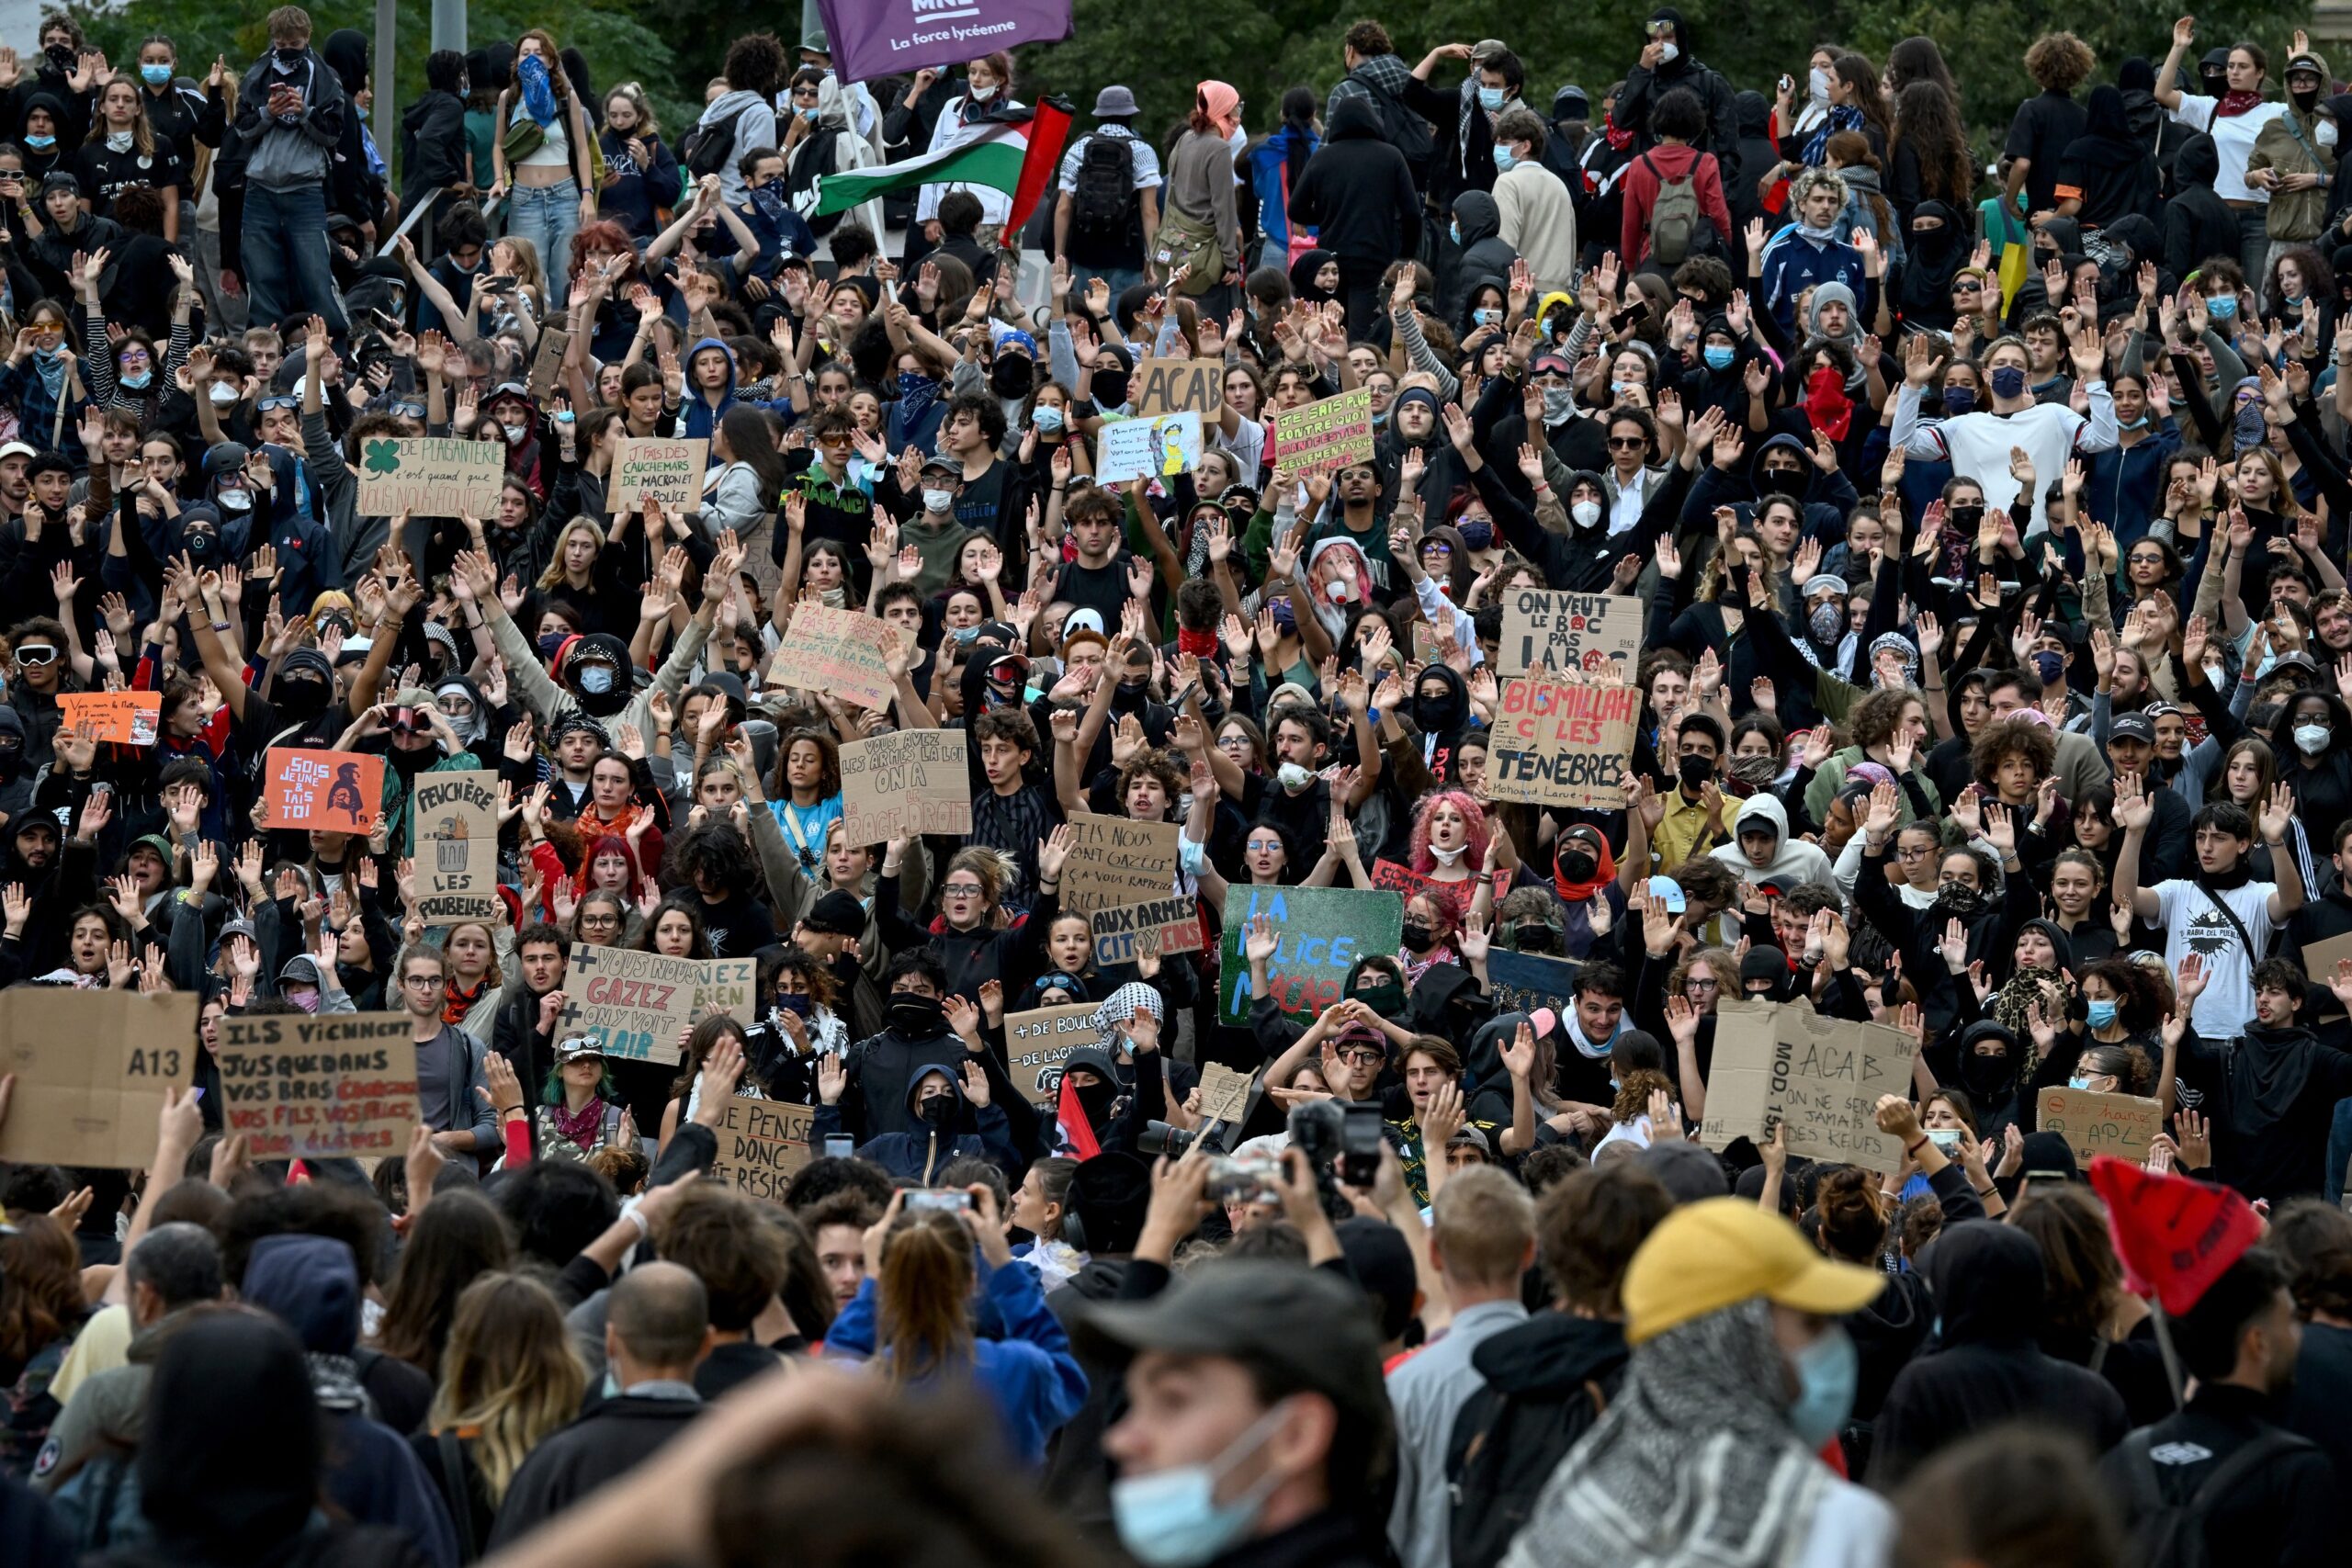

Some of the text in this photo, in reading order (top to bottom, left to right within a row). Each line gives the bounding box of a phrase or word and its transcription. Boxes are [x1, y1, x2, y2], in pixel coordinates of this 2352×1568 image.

[891, 20, 1015, 51] La force lycéenne
[1140, 367, 1221, 412] ACAB
[1279, 412, 1303, 427] JE
[1346, 391, 1371, 409] PLUS
[1277, 419, 1332, 442] CONTRE
[401, 440, 418, 456] DE
[643, 446, 662, 460] FAIS
[664, 447, 688, 458] DES
[1279, 442, 1347, 470] TELLEMENT
[1349, 437, 1373, 450] VOUS
[396, 467, 491, 486] c'est quand que
[623, 461, 689, 473] CAUCHEMARS
[622, 474, 694, 487] DE MACRON ET
[361, 485, 391, 514] VOUS
[397, 486, 431, 515] NOUS
[828, 610, 838, 620] 2
[1518, 592, 1611, 617] ON VEUT
[800, 616, 824, 630] PAS
[826, 622, 842, 633] DE
[1531, 615, 1601, 634] LE BAC
[1548, 633, 1581, 647] PAS
[799, 642, 819, 651] CAF
[843, 651, 857, 661] LA
[800, 671, 815, 684] TU
[865, 687, 882, 698] ME
[1518, 718, 1535, 738] C
[1555, 720, 1602, 744] LES
[865, 733, 939, 754] VOUS AVEZ
[291, 757, 329, 778] SOIS
[842, 747, 963, 774] LES ARMES LA LOI
[1496, 744, 1623, 787] TÉNÈBRES
[280, 766, 319, 786] JEUNE
[876, 762, 926, 794] ON A
[284, 790, 313, 803] TAIS
[295, 783, 303, 792] &
[417, 777, 495, 814] PEUCHÈRE
[282, 804, 309, 818] TOI
[844, 789, 919, 815] LA LE
[846, 801, 970, 847] RAGE DROIT
[1112, 827, 1152, 847] NOUS
[1070, 847, 1103, 863] ONT
[434, 875, 472, 892] LES
[1096, 872, 1123, 884] VOUS
[1128, 877, 1173, 891] RAPPELLE
[418, 897, 492, 919] POUBELLES
[1068, 891, 1107, 908] RIEN
[1093, 897, 1197, 934] AUX ARMES
[1098, 921, 1200, 962] CITOYENS
[2220, 930, 2240, 939] PUEBLO
[597, 948, 650, 977] VOUS
[650, 958, 699, 985] NOUS
[586, 977, 676, 1010] GAZEZ
[227, 1021, 281, 1045] ILS
[631, 1012, 676, 1034] VOIT
[1032, 1021, 1051, 1036] DE
[128, 1049, 180, 1077] A13
[1800, 1043, 1883, 1081] ACAB
[223, 1080, 271, 1101] VOS
[278, 1080, 333, 1100] BRAS
[1786, 1089, 1807, 1105] ON
[1815, 1096, 1832, 1110] NE
[748, 1106, 812, 1143] PENSE
[2088, 1123, 2142, 1145] APL
[1785, 1127, 1882, 1154] DES KEUFS
[734, 1136, 788, 1170] DONC
